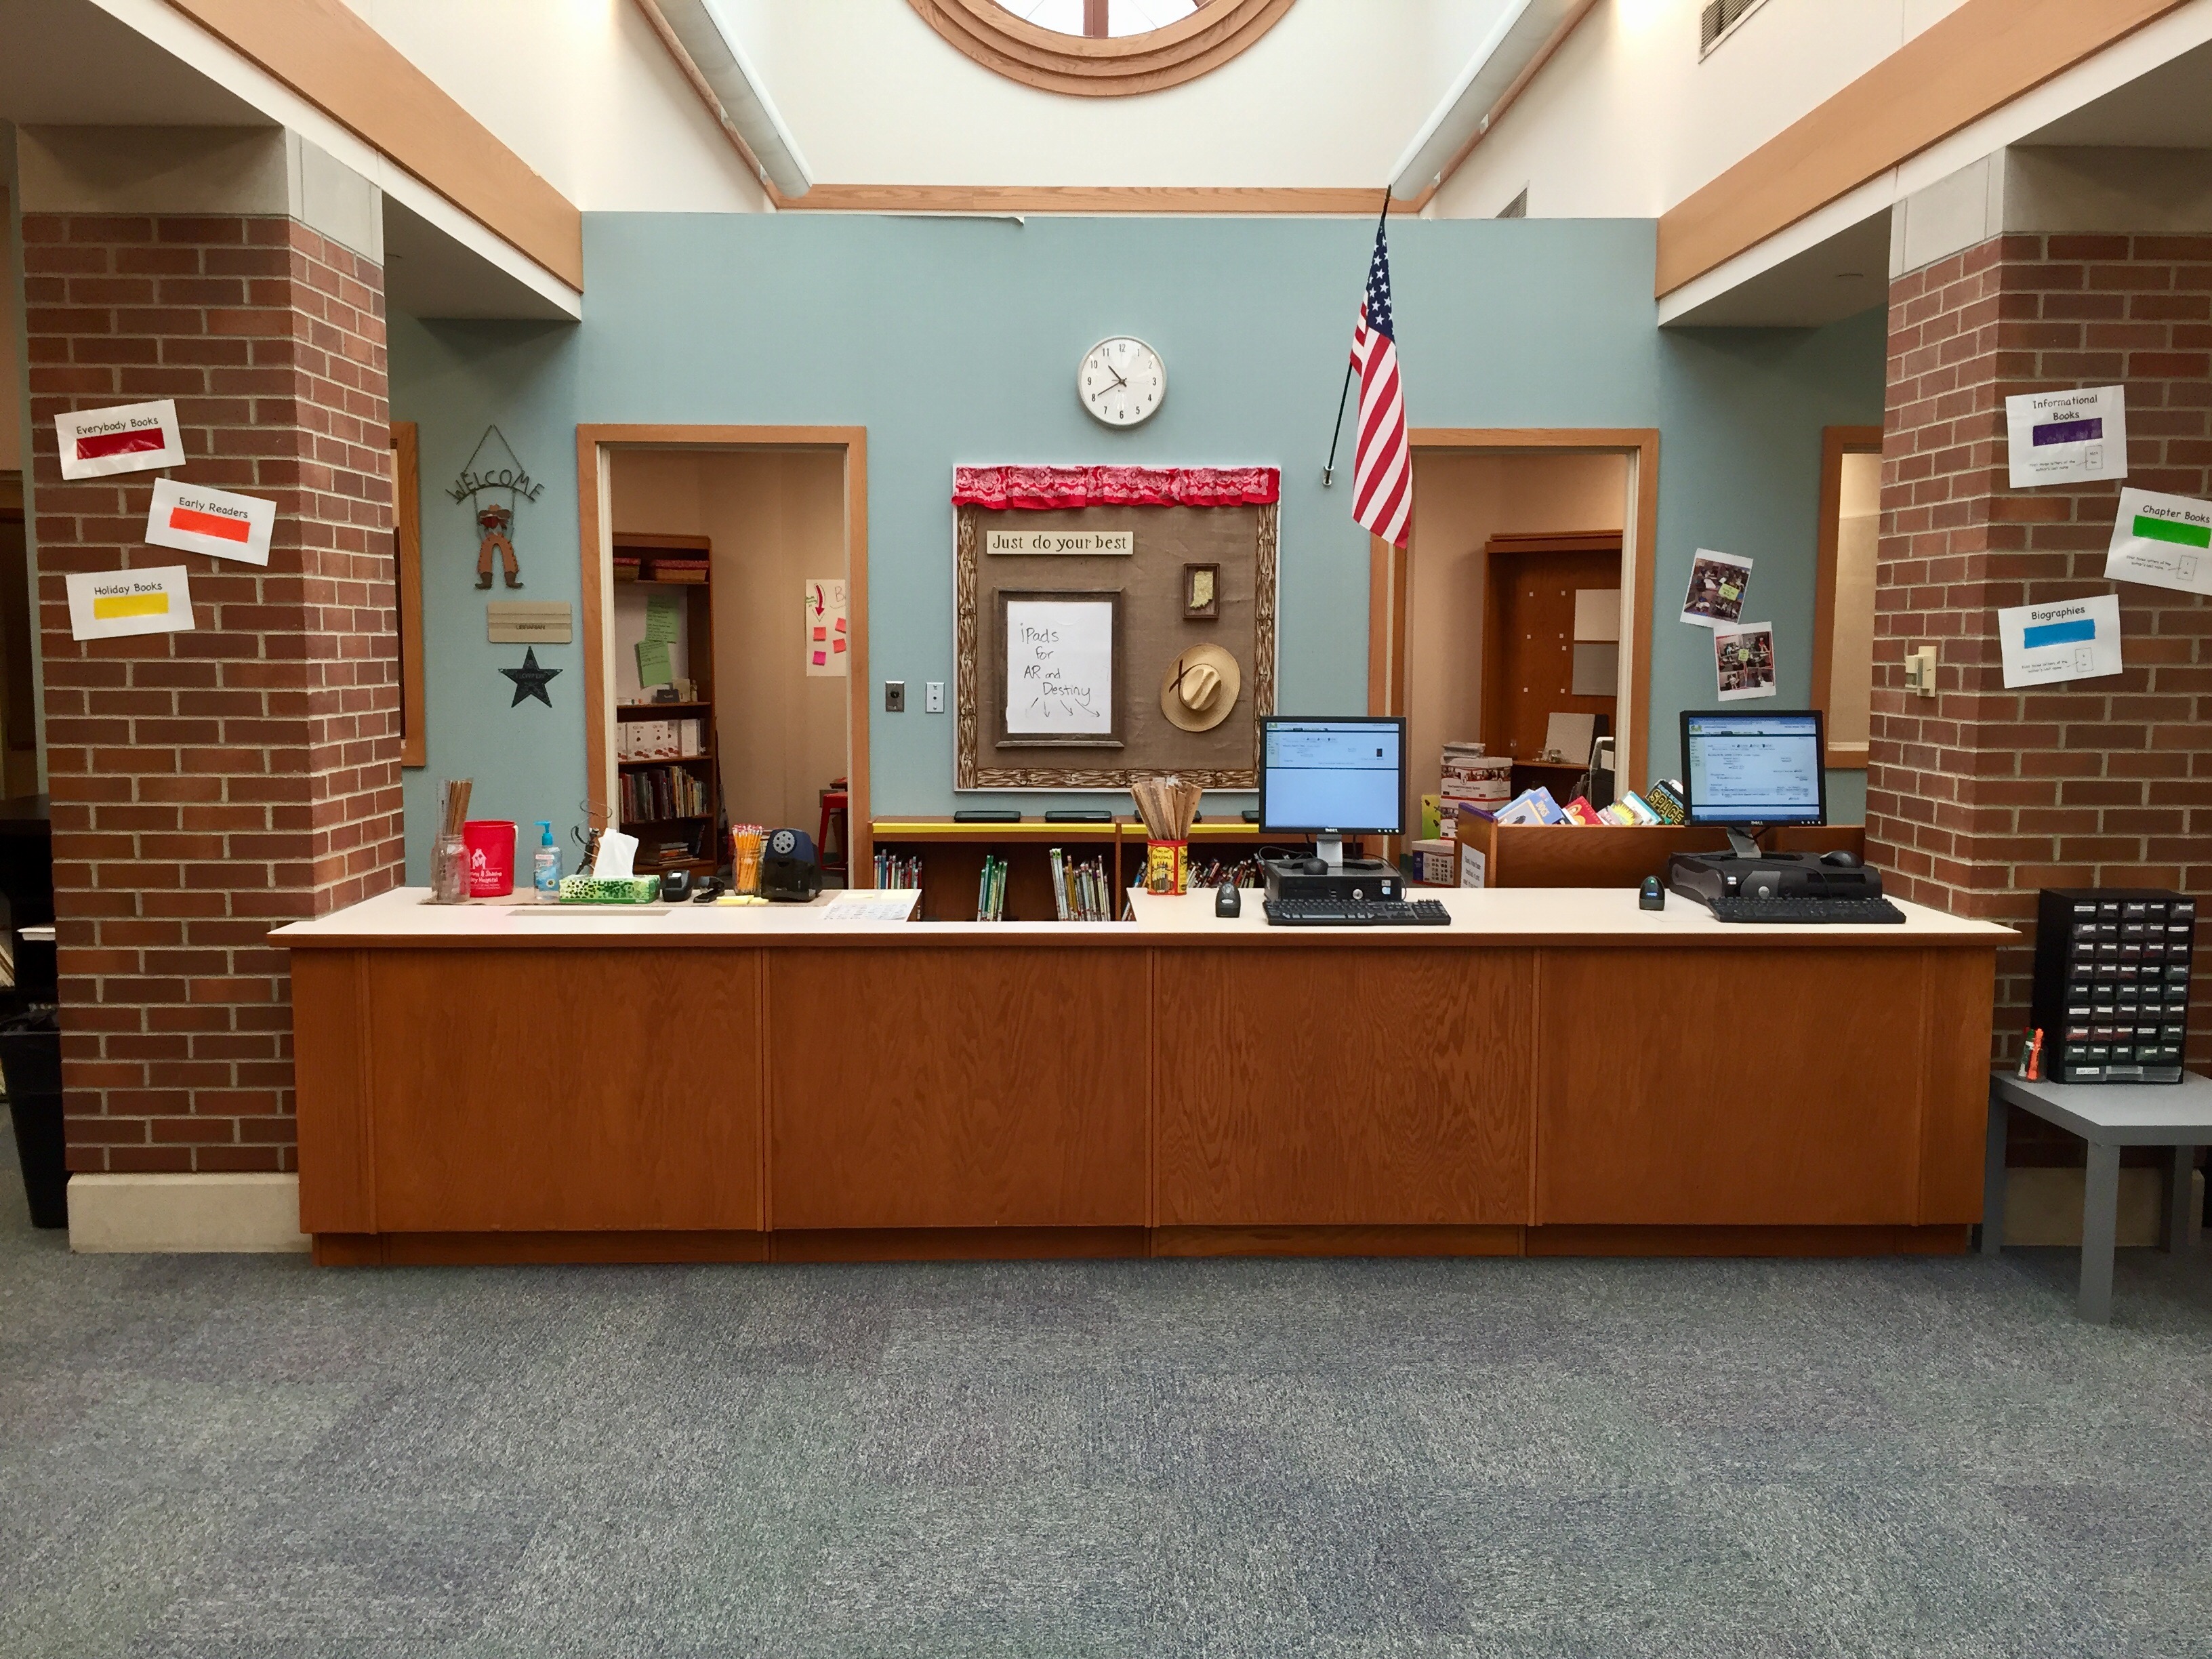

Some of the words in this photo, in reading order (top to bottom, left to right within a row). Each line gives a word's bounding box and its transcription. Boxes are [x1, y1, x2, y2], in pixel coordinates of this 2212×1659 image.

[1103, 348, 1109, 356] 11
[1119, 344, 1126, 352] 12
[1090, 360, 1098, 369] 10
[1148, 361, 1152, 369] 2
[1087, 377, 1092, 386] 9
[1153, 377, 1157, 386] 3
[1092, 394, 1096, 402] 8
[2032, 395, 2098, 409] Informational
[1103, 406, 1107, 414] 7
[1120, 411, 1124, 419] 6
[2053, 411, 2080, 421] Books
[76, 421, 126, 435] Everybody
[131, 416, 159, 427] Books
[445, 468, 545, 502] WELCOME
[179, 497, 206, 512] Early
[209, 503, 249, 519] Readers
[2142, 505, 2182, 520] Chapter
[2184, 511, 2211, 524] Books
[992, 534, 1023, 550] Just
[1032, 534, 1052, 549] do
[1054, 536, 1092, 552] your
[1094, 534, 1127, 549] best
[94, 585, 129, 596] Holiday
[134, 582, 163, 592] Books
[2031, 605, 2085, 621] Biographies
[1019, 623, 1059, 643] iPads
[1036, 644, 1054, 661] for
[1023, 665, 1041, 679] AR
[1045, 668, 1061, 679] and
[1042, 682, 1092, 705] Destiny
[1647, 787, 1685, 825] SPACE
